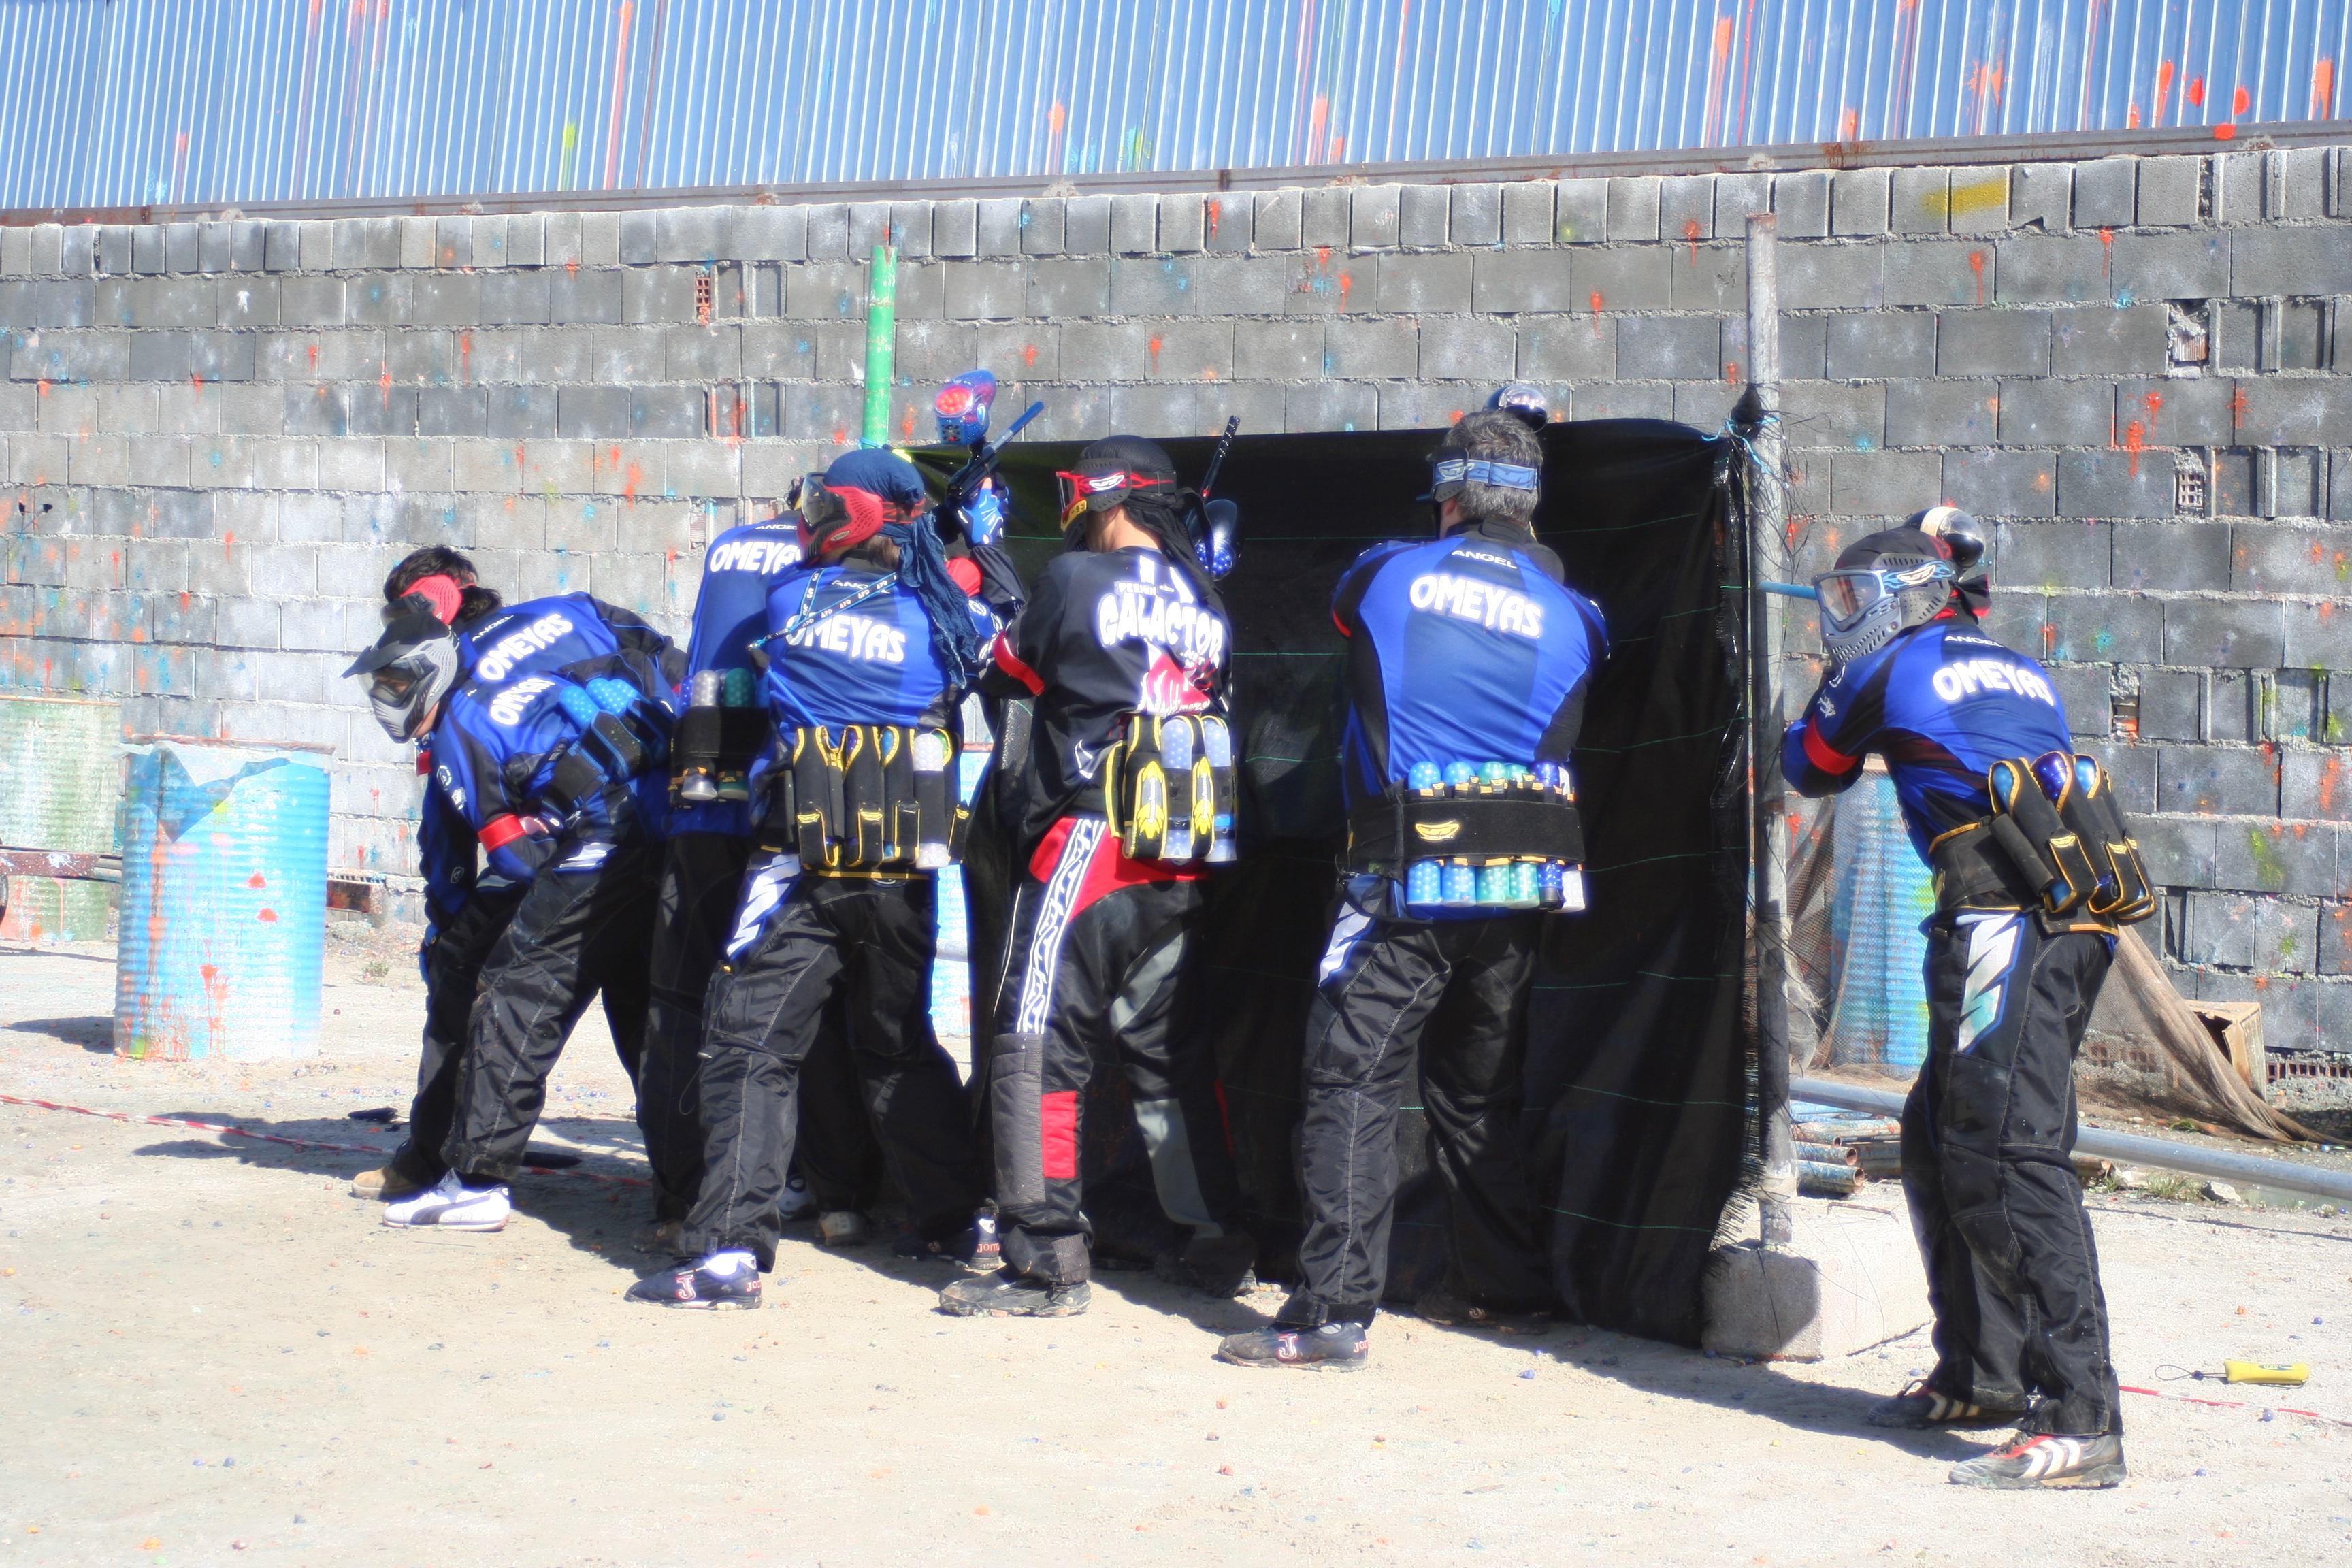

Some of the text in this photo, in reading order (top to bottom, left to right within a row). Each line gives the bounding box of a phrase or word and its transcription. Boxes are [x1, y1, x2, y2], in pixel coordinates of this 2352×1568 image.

[1451, 550, 1517, 569] ANGEL
[1099, 592, 1223, 668] GALACTOR
[1410, 576, 1541, 637] OMEYAS
[479, 613, 573, 680] OMEYAS
[786, 612, 906, 663] OMEYAS
[1933, 660, 2054, 706] OMEYAS
